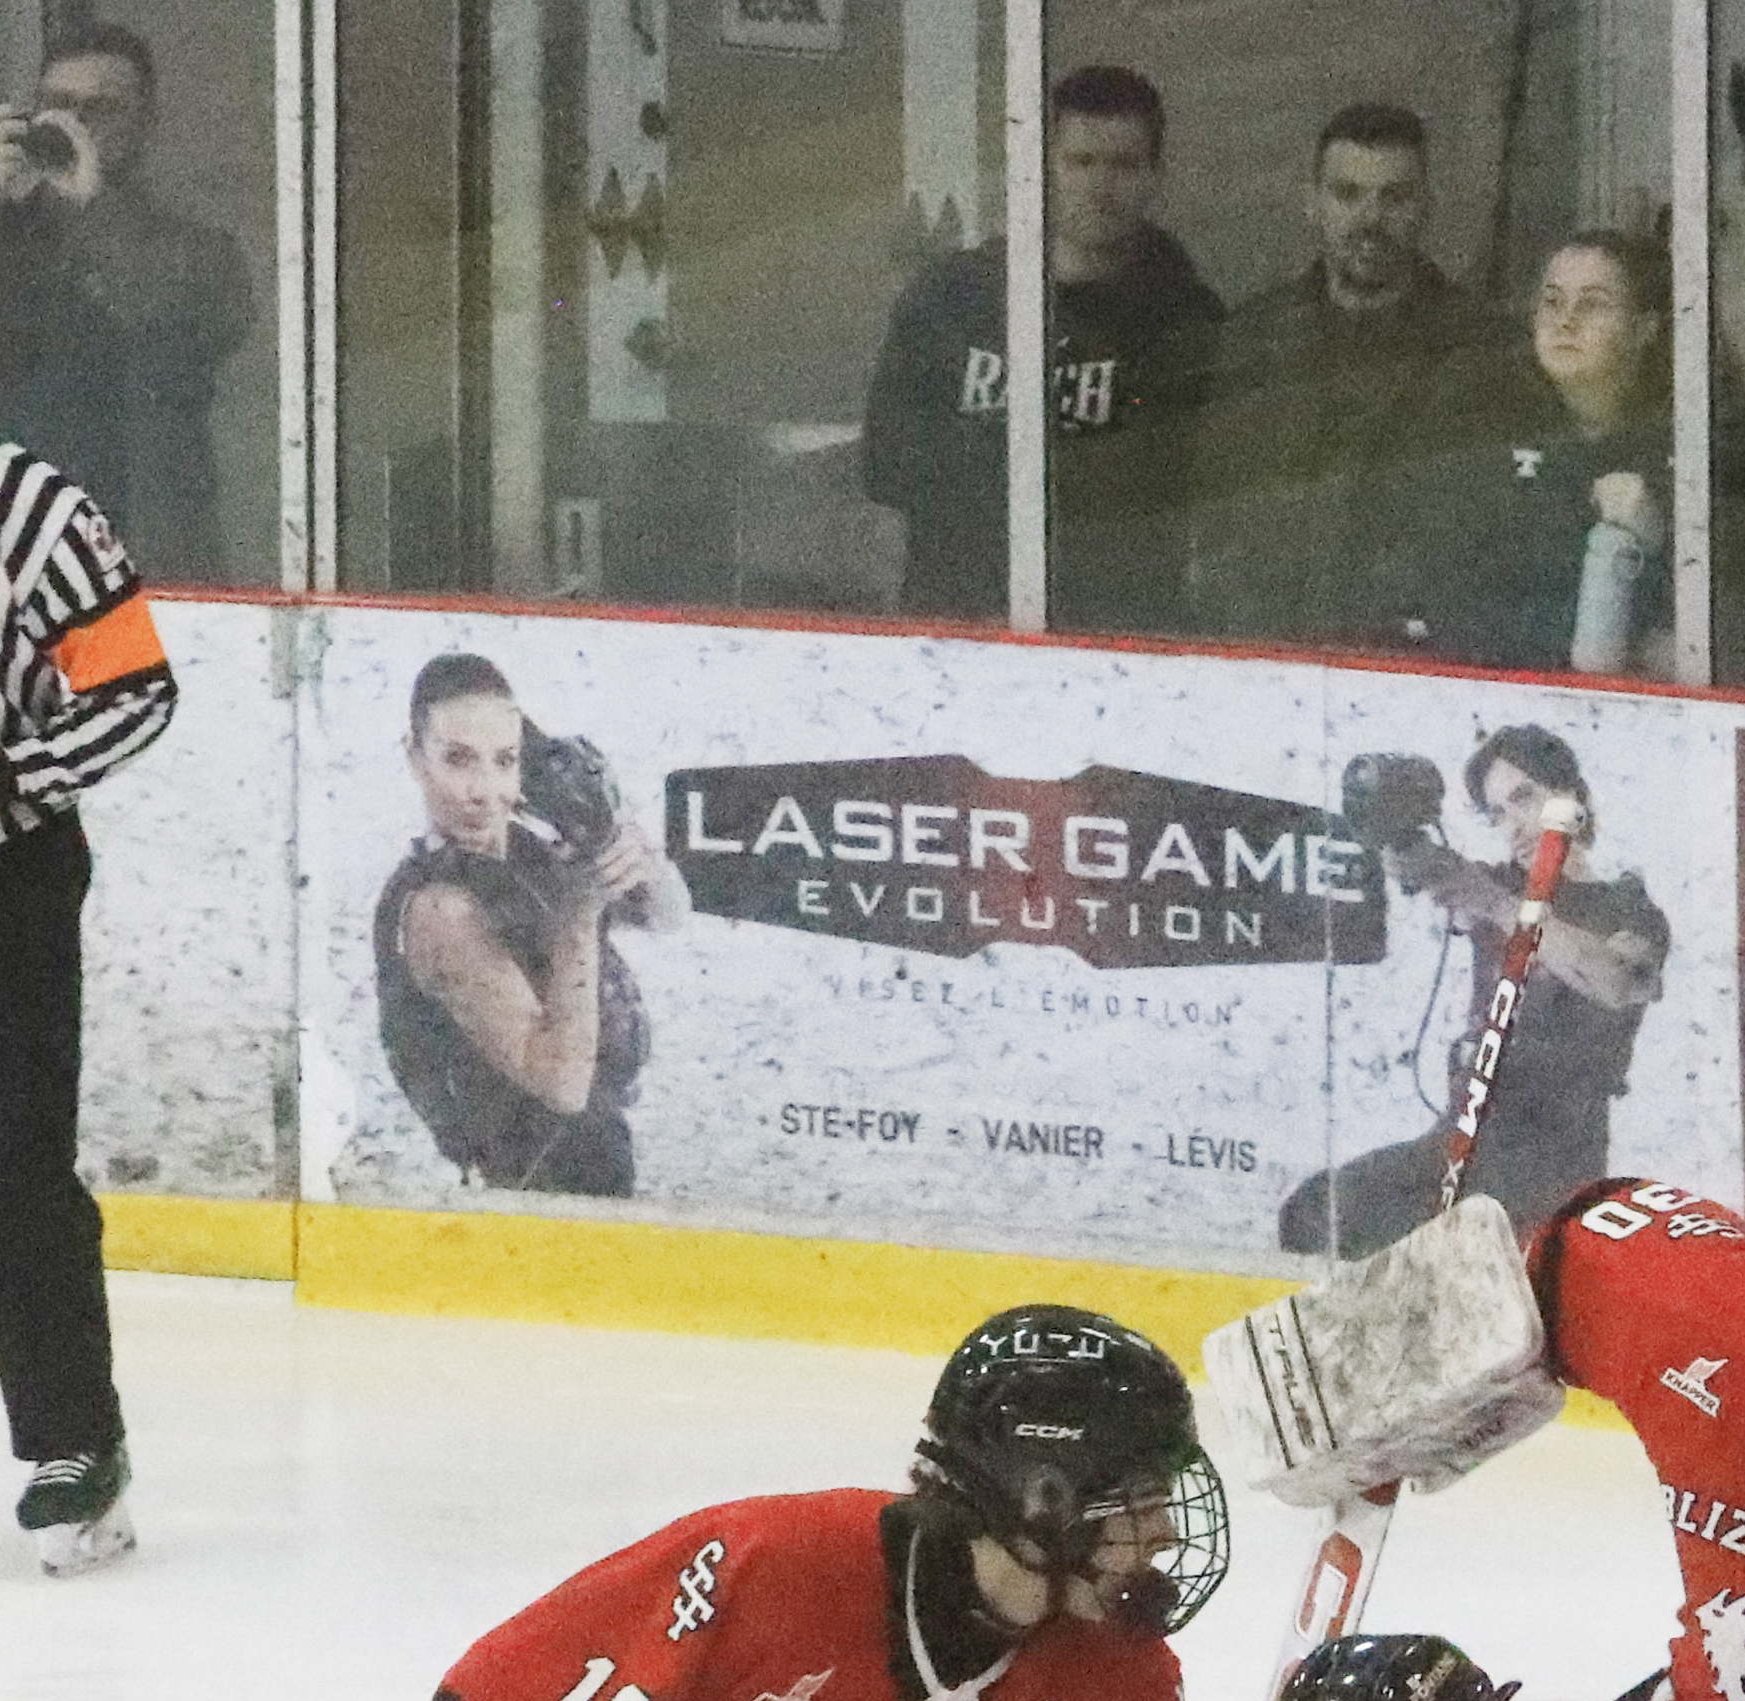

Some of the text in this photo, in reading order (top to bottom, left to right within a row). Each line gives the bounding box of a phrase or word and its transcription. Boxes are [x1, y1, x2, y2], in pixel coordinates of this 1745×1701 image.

[686, 790, 1366, 904] LASER GAME
[797, 879, 1263, 947] EVOLUTION
[1457, 977, 1517, 1138] CCM
[780, 1102, 922, 1143] STE-FOY
[982, 1117, 1107, 1159] VANIER
[1167, 1127, 1257, 1172] LÉVIS
[1014, 1423, 1085, 1440] CCM
